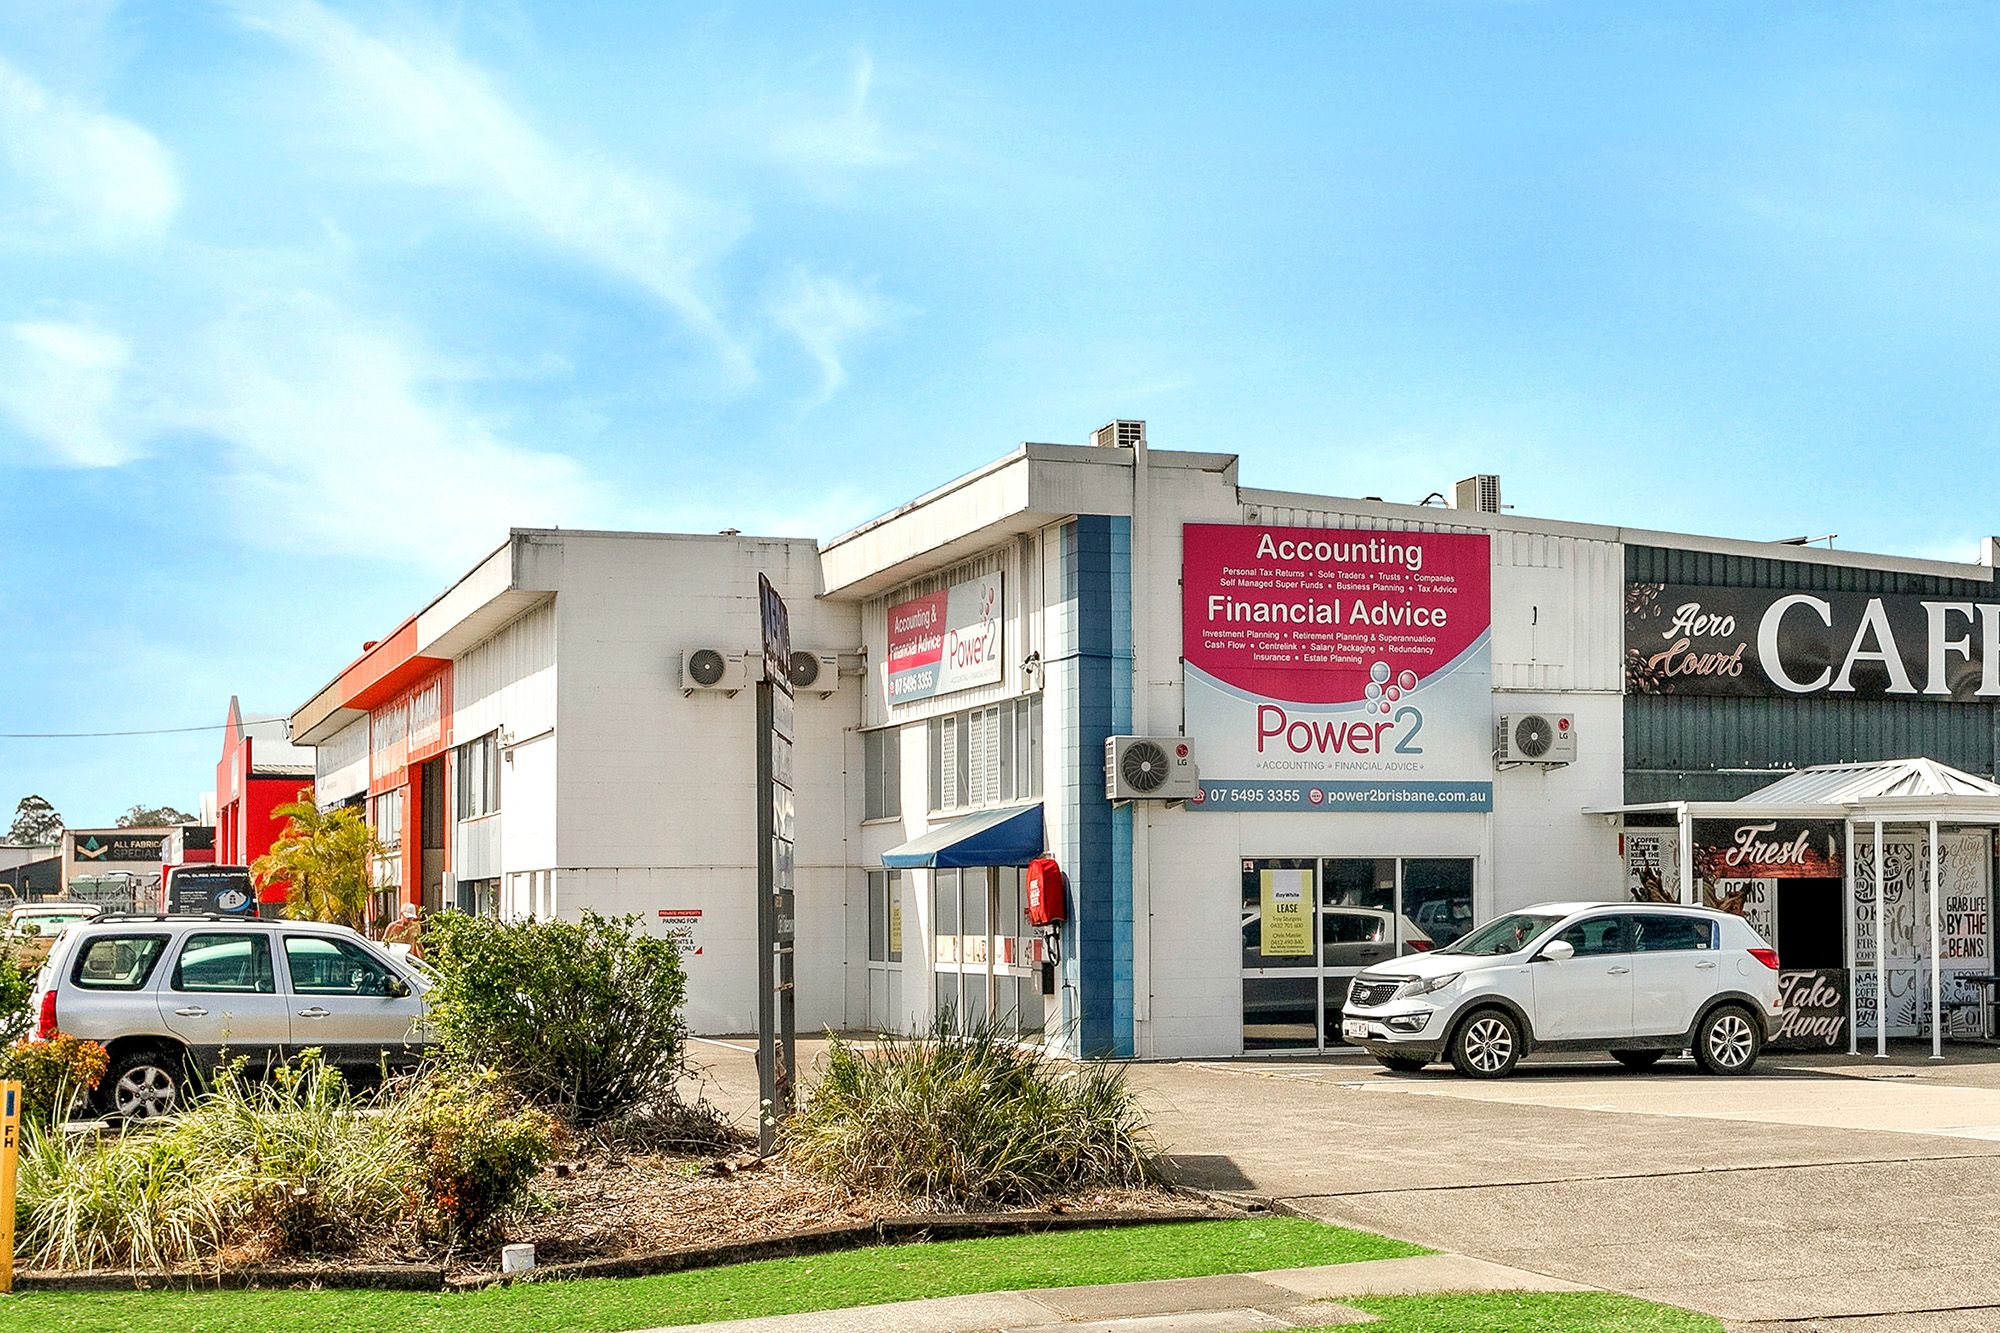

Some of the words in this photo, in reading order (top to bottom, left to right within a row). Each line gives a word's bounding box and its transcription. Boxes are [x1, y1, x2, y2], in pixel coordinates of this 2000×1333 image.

[1256, 533, 1423, 571] Accounting
[1223, 567, 1257, 577] Personal
[1259, 568, 1274, 577] Tax
[1276, 569, 1304, 578] Returns
[1318, 570, 1335, 579] Sole
[1337, 571, 1365, 580] Traders
[1378, 572, 1401, 581] Trusts
[1414, 573, 1455, 584] Companies
[1220, 578, 1233, 587] Self
[1235, 579, 1273, 589] Managed
[1276, 580, 1298, 590] Super
[1300, 581, 1323, 589] Funds
[1337, 582, 1370, 591] Business
[1373, 583, 1404, 593] Planning
[1418, 585, 1430, 593] Tax
[1433, 585, 1457, 594] Advice
[1208, 595, 1340, 625] Financial
[1349, 599, 1448, 627] Advice
[894, 608, 930, 634] Accounting
[931, 604, 937, 623] &
[1662, 602, 1736, 639] Aero
[1203, 630, 1244, 639] Investment
[1247, 631, 1280, 641] Planning
[1293, 632, 1333, 641] Retirement
[1336, 632, 1369, 643] Planning
[1371, 633, 1376, 641] &
[1378, 634, 1436, 644] Superannuation
[889, 637, 917, 662] Financial
[918, 634, 941, 653] Advice
[950, 617, 996, 670] Power2
[1205, 641, 1225, 649] Cash
[1228, 641, 1246, 650] Flow
[1259, 642, 1298, 651] Centrelink
[1310, 643, 1335, 653] Salary
[1337, 643, 1376, 654] Packaging
[1388, 645, 1434, 655] Redundancy
[1254, 653, 1291, 662] Insurance
[1304, 654, 1327, 663] Estate
[1330, 655, 1362, 664] Planning
[1648, 637, 1747, 677] Court
[1256, 703, 1424, 755] Power2
[1262, 761, 1325, 770] ACCOUNTING
[1335, 761, 1382, 770] FINANCIAL
[1385, 762, 1419, 771] ADVICE
[1211, 789, 1229, 801] 07
[1231, 789, 1265, 801] 5495
[1267, 789, 1300, 801] 3355
[1328, 790, 1486, 805] power2brisbane.com.au
[1726, 821, 1810, 867] Fresh
[1277, 904, 1298, 913] LEASE
[1946, 896, 1968, 912] GRAB
[1969, 897, 1986, 912] LIFE
[1947, 914, 1962, 935] BY
[1964, 914, 1987, 935] THE
[1949, 938, 1984, 957] BEANS
[1778, 969, 1841, 1009] Take
[1767, 1006, 1846, 1047] Away
